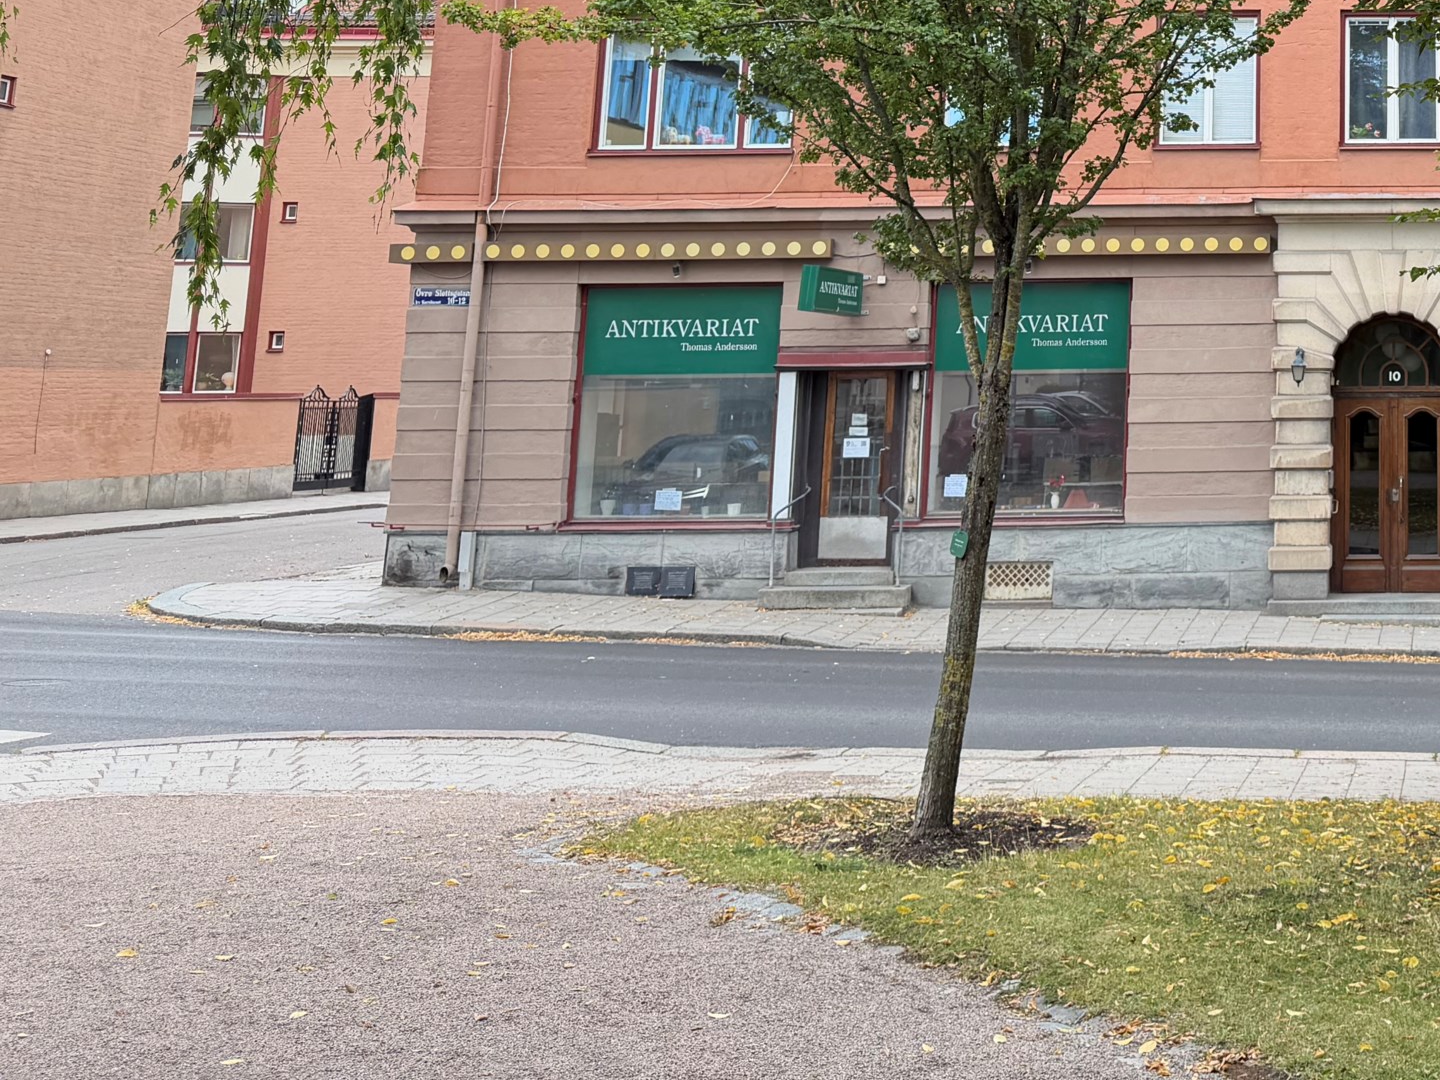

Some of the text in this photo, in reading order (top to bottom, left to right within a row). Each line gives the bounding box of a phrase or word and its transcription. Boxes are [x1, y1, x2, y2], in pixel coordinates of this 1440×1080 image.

[416, 288, 432, 297] Övre
[819, 281, 858, 297] ANTIKVARIAT
[605, 318, 760, 338] ANTIKVARIAT
[680, 342, 758, 352] Thomas Andersson
[1031, 337, 1108, 347] Thomas Andersson
[1388, 370, 1401, 382] 10
